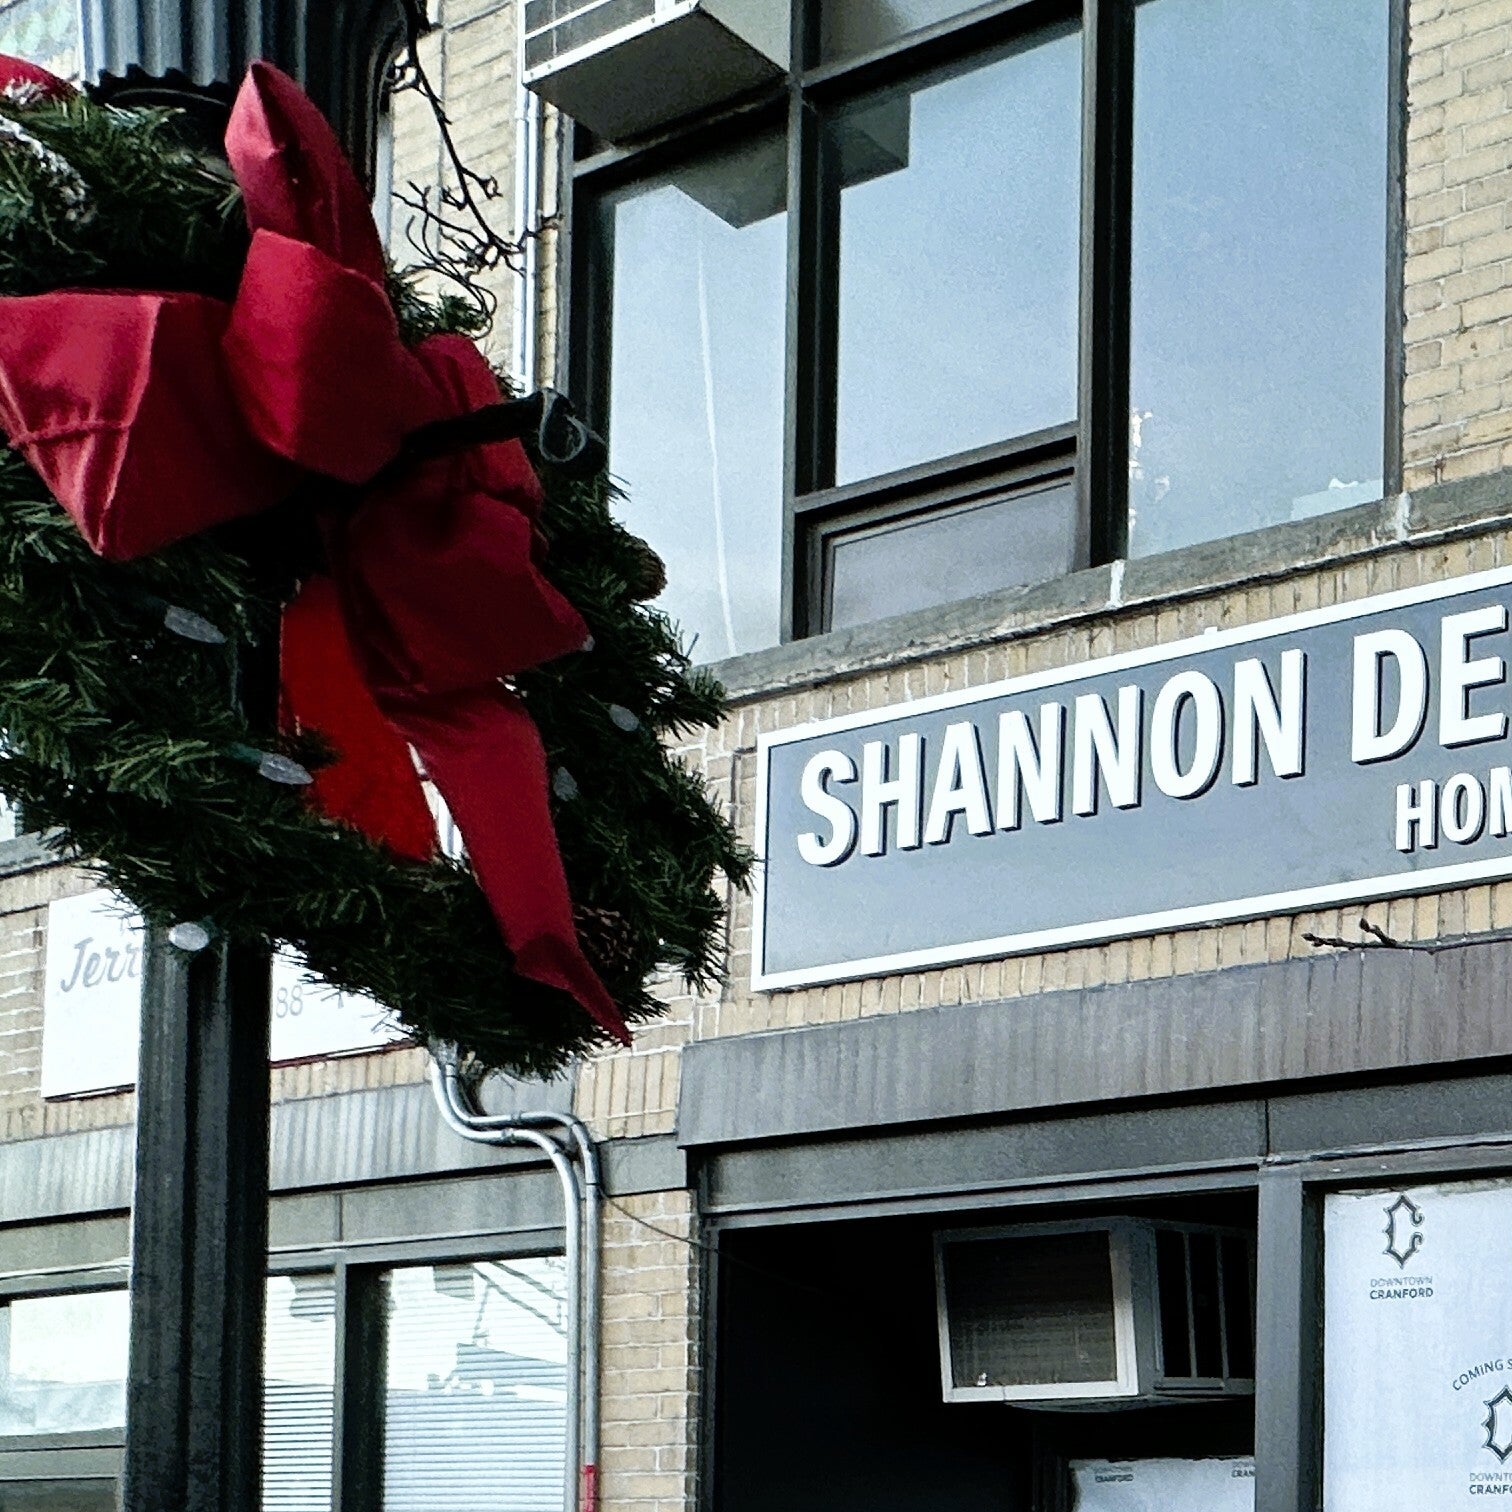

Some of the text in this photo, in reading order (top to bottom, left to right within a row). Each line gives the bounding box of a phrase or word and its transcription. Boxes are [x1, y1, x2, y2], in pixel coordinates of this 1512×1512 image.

[797, 647, 1306, 868] SHANNON
[1369, 1287, 1434, 1300] CRANFORD
[1370, 1276, 1433, 1288] DOWNTOWN
[1452, 1358, 1504, 1391] COMING
